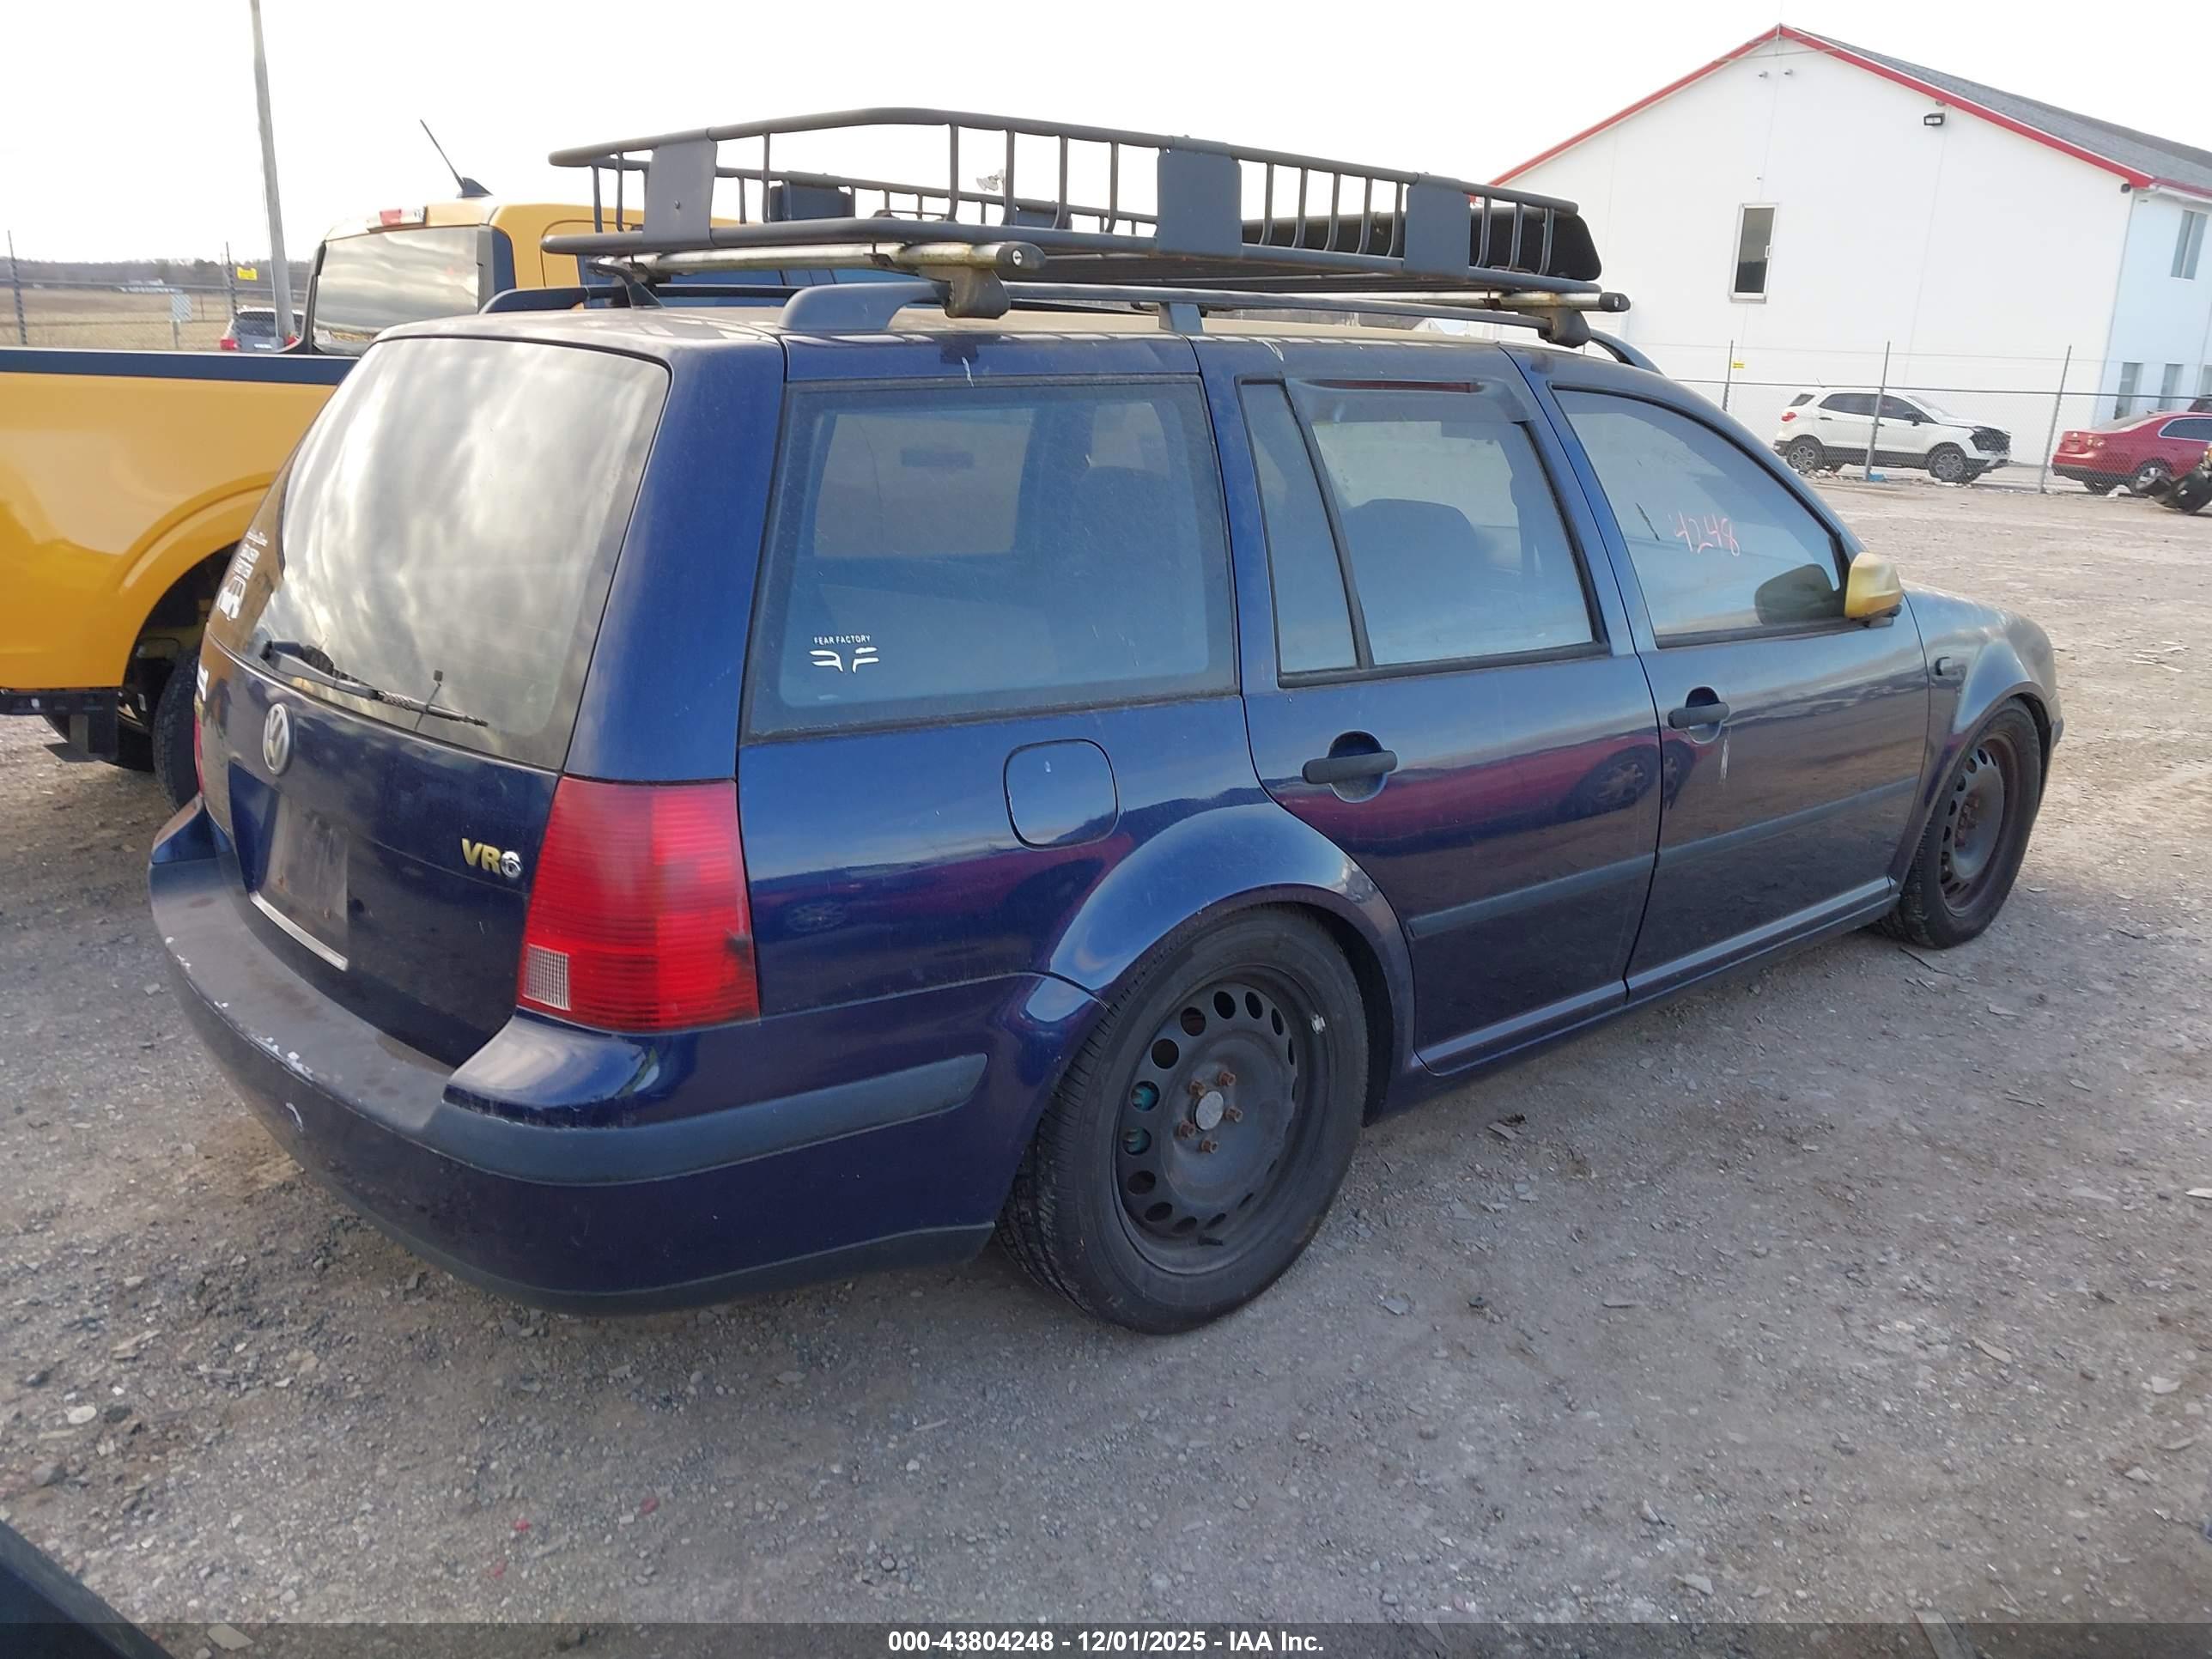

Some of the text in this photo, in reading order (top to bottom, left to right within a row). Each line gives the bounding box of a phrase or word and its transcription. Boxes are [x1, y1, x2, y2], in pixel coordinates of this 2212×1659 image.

[1674, 510, 1741, 557] 4248
[812, 634, 871, 646] FEAR FACTORY
[461, 837, 523, 879] VR6
